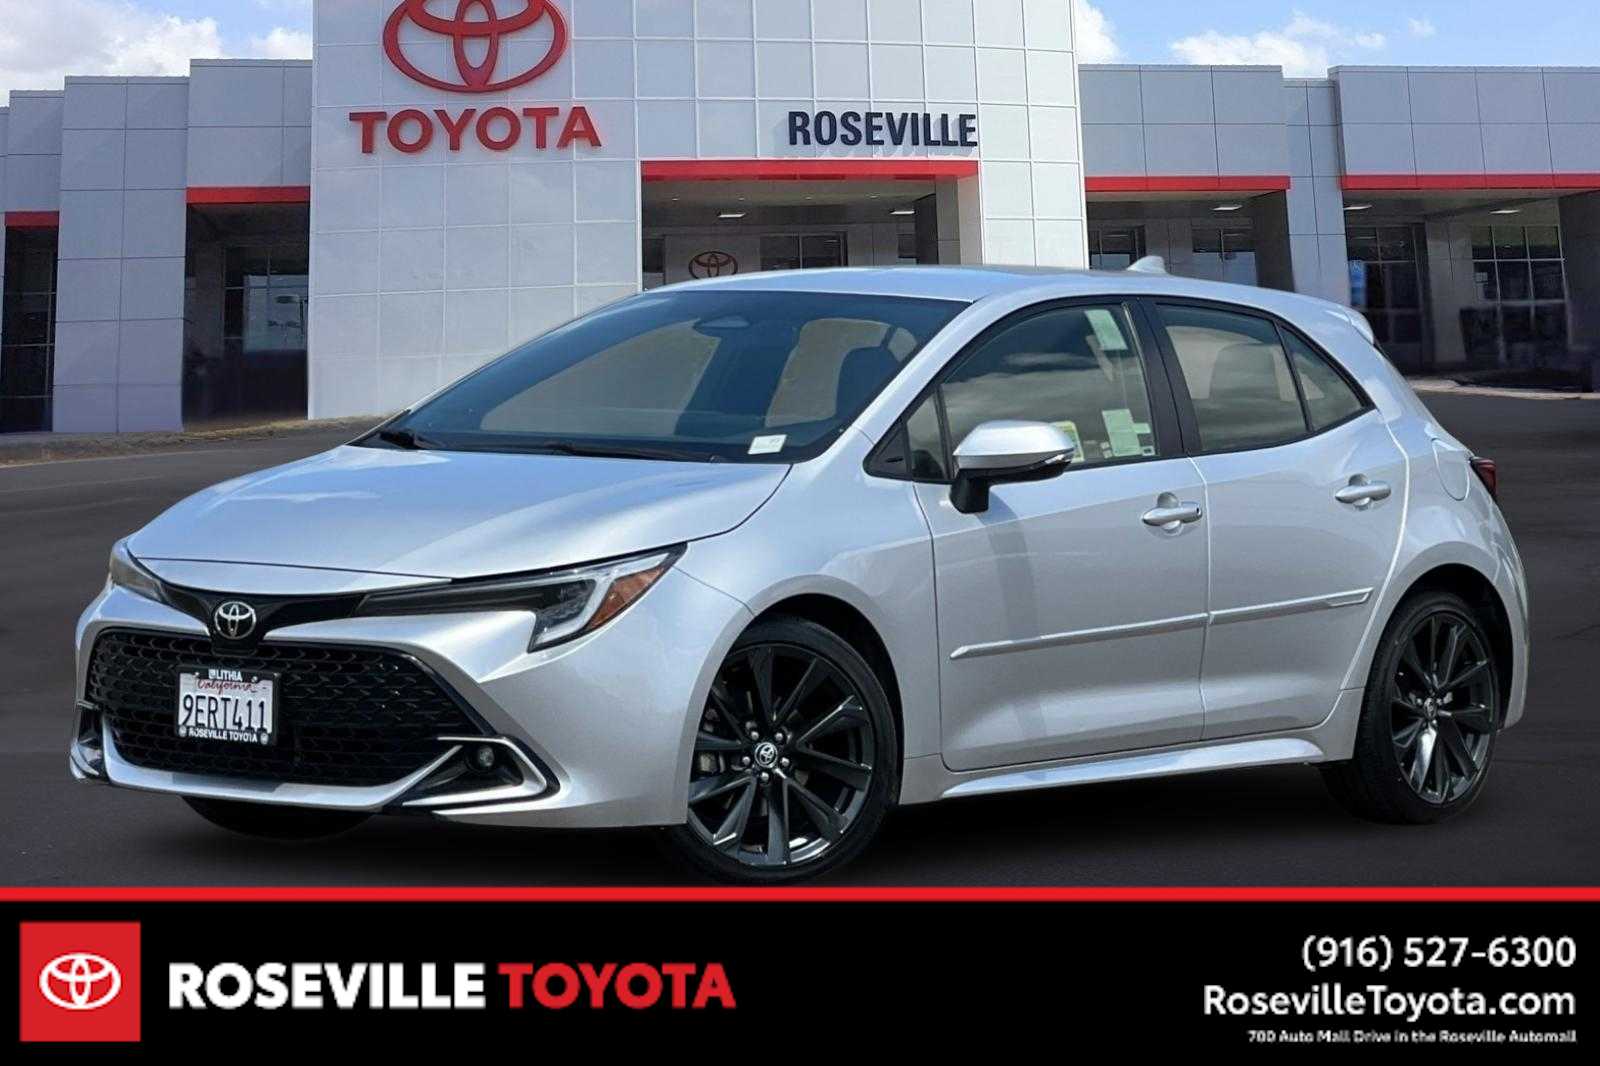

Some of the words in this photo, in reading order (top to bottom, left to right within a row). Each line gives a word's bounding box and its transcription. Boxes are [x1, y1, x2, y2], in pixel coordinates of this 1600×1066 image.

[350, 105, 602, 153] TOYOTA
[788, 111, 978, 147] ROSEVILLE
[182, 694, 267, 731] 9ERT411
[188, 727, 228, 740] ROSEVILLE
[229, 730, 258, 742] TOYOTA
